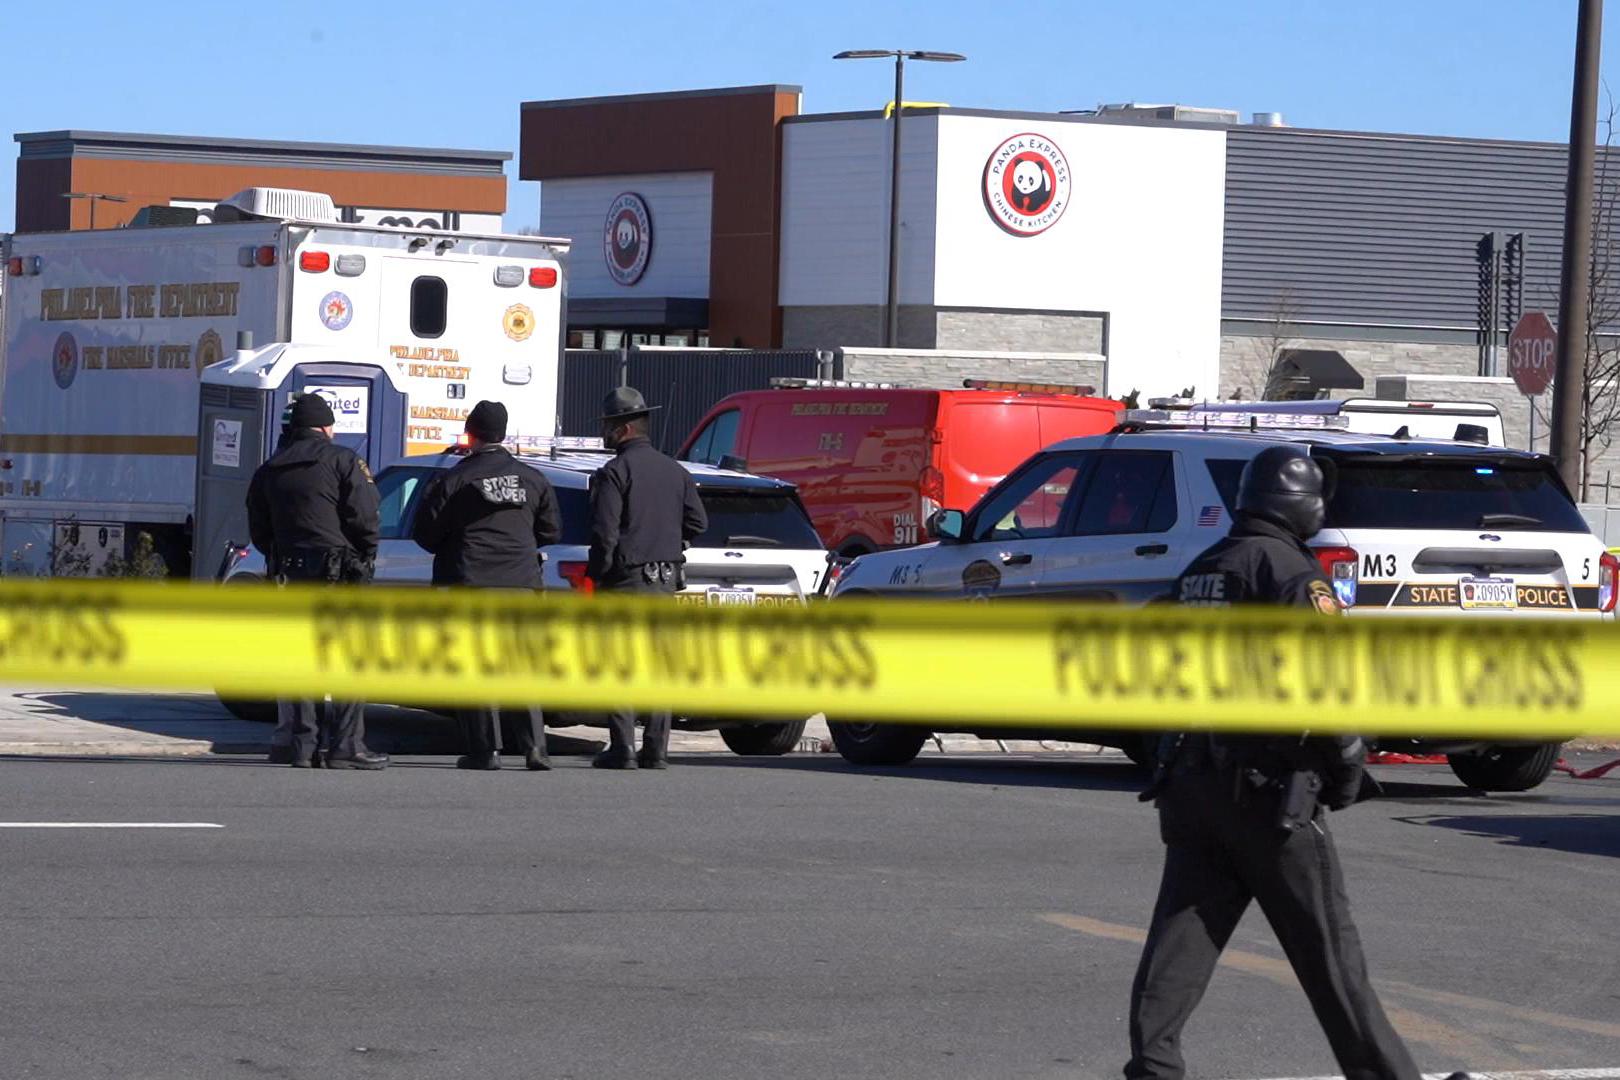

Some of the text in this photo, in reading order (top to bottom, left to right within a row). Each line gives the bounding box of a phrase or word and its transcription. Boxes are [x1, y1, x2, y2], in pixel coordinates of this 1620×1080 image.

[993, 139, 1066, 182] PANDA EXPRESS
[993, 192, 1062, 227] CHINESE KITCHEN
[390, 345, 459, 362] PHILADELPHIA
[1511, 339, 1554, 369] STOP
[408, 363, 471, 380] DEPARTMENT
[483, 475, 519, 492] STATE
[894, 513, 917, 527] DIAL
[894, 527, 918, 544] 911
[1363, 554, 1590, 580] M3 5
[813, 570, 820, 589] 7
[1181, 574, 1225, 600] STATE
[1411, 588, 1456, 603] STATE
[1517, 589, 1567, 605] POLICE
[312, 601, 465, 675] POLICE
[737, 607, 877, 690] CROSS
[1053, 616, 1197, 697] POLICE
[1450, 621, 1585, 711] CROSS
